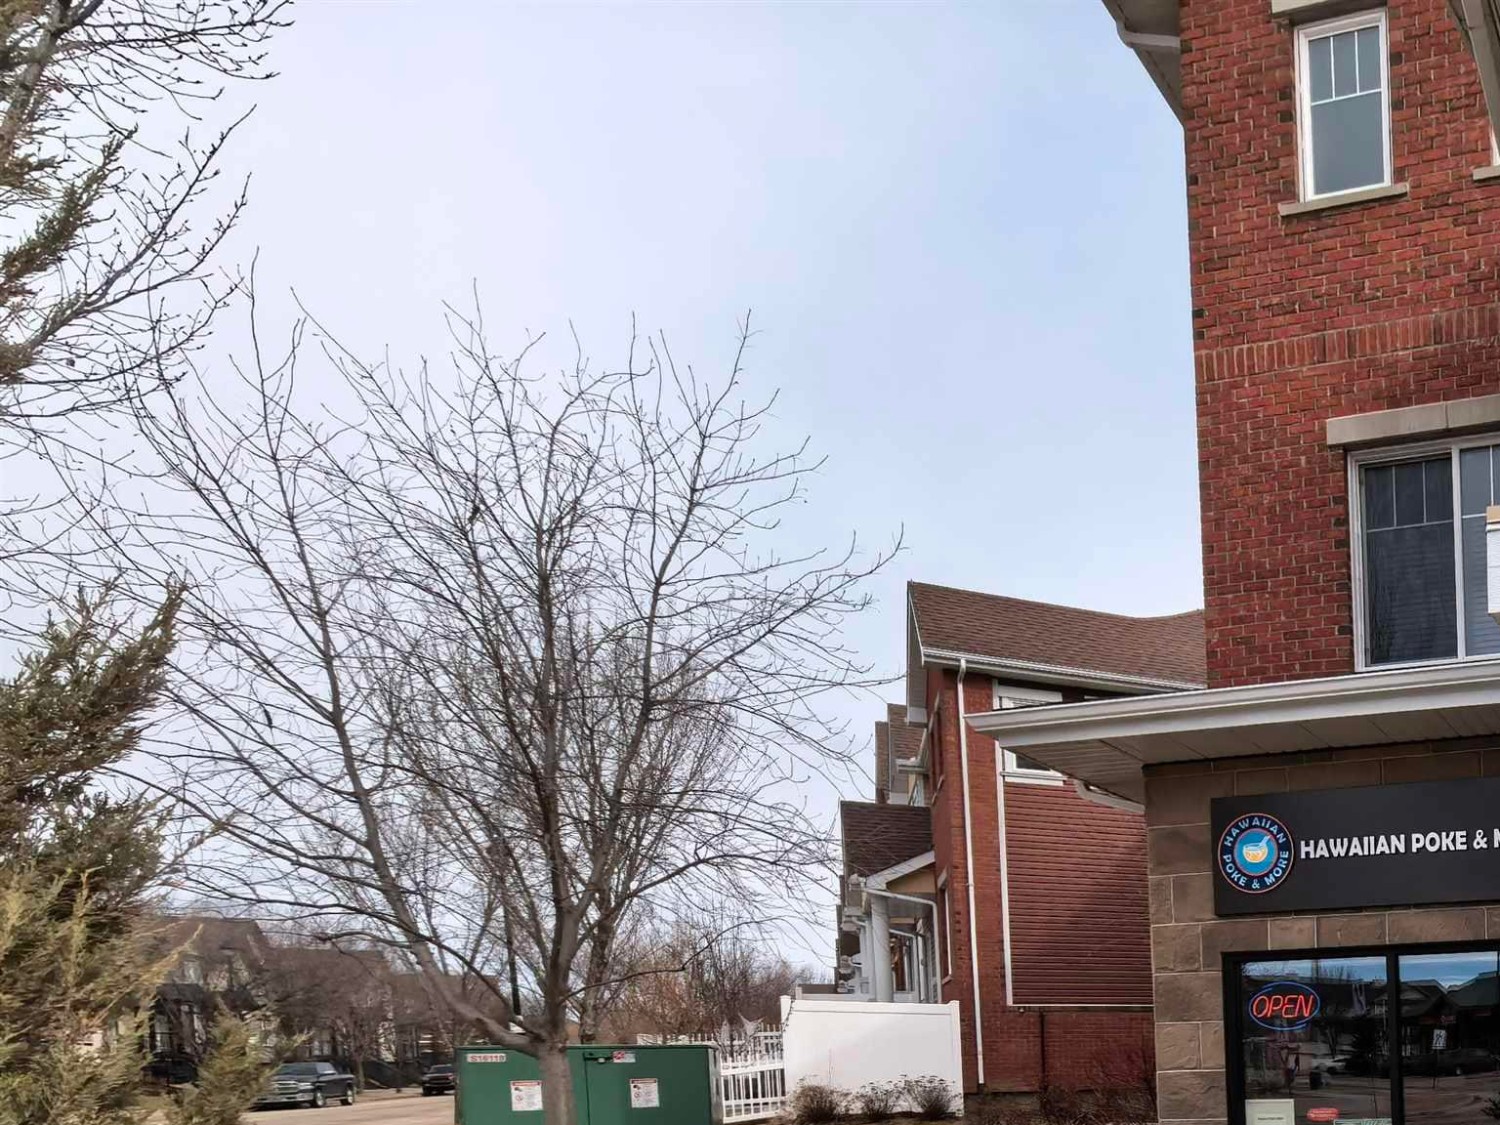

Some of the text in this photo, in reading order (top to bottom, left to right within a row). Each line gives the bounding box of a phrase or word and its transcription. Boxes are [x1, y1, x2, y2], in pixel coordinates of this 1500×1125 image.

[1224, 816, 1287, 847] HAWAIIAN
[1300, 833, 1405, 860] HAWAIIAN
[1411, 829, 1467, 853] POKE
[1472, 829, 1488, 849] &
[1223, 850, 1289, 889] POKE & MORE
[1252, 994, 1315, 1018] OPEN
